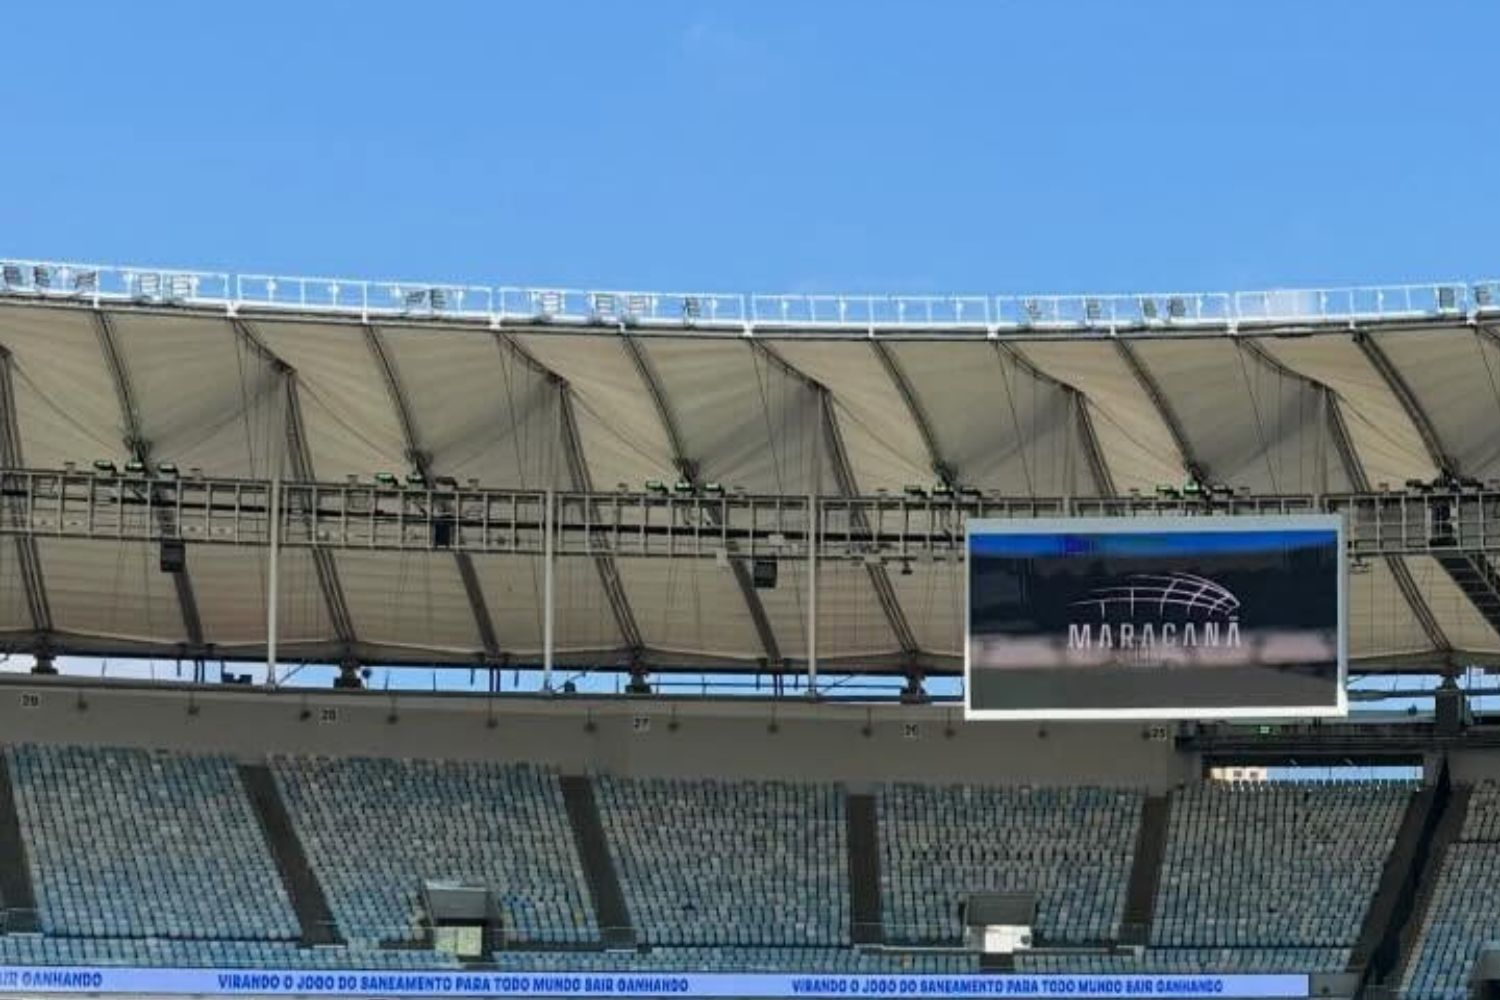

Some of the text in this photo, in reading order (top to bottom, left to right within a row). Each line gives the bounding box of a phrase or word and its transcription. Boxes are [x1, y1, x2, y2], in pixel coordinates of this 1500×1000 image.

[1068, 616, 1241, 649] MARACANÃ
[218, 974, 279, 989] VIRANDO
[284, 975, 293, 989] O
[297, 975, 334, 990] JOGO
[338, 975, 357, 990] DO
[360, 976, 452, 990] SANEAMENTO
[456, 976, 491, 991] PARA
[495, 977, 530, 991] TODO
[533, 977, 581, 992] MUNDO
[850, 979, 859, 993] O
[901, 979, 916, 993] DO
[1006, 979, 1038, 993] PARA
[1042, 979, 1075, 993] TODO
